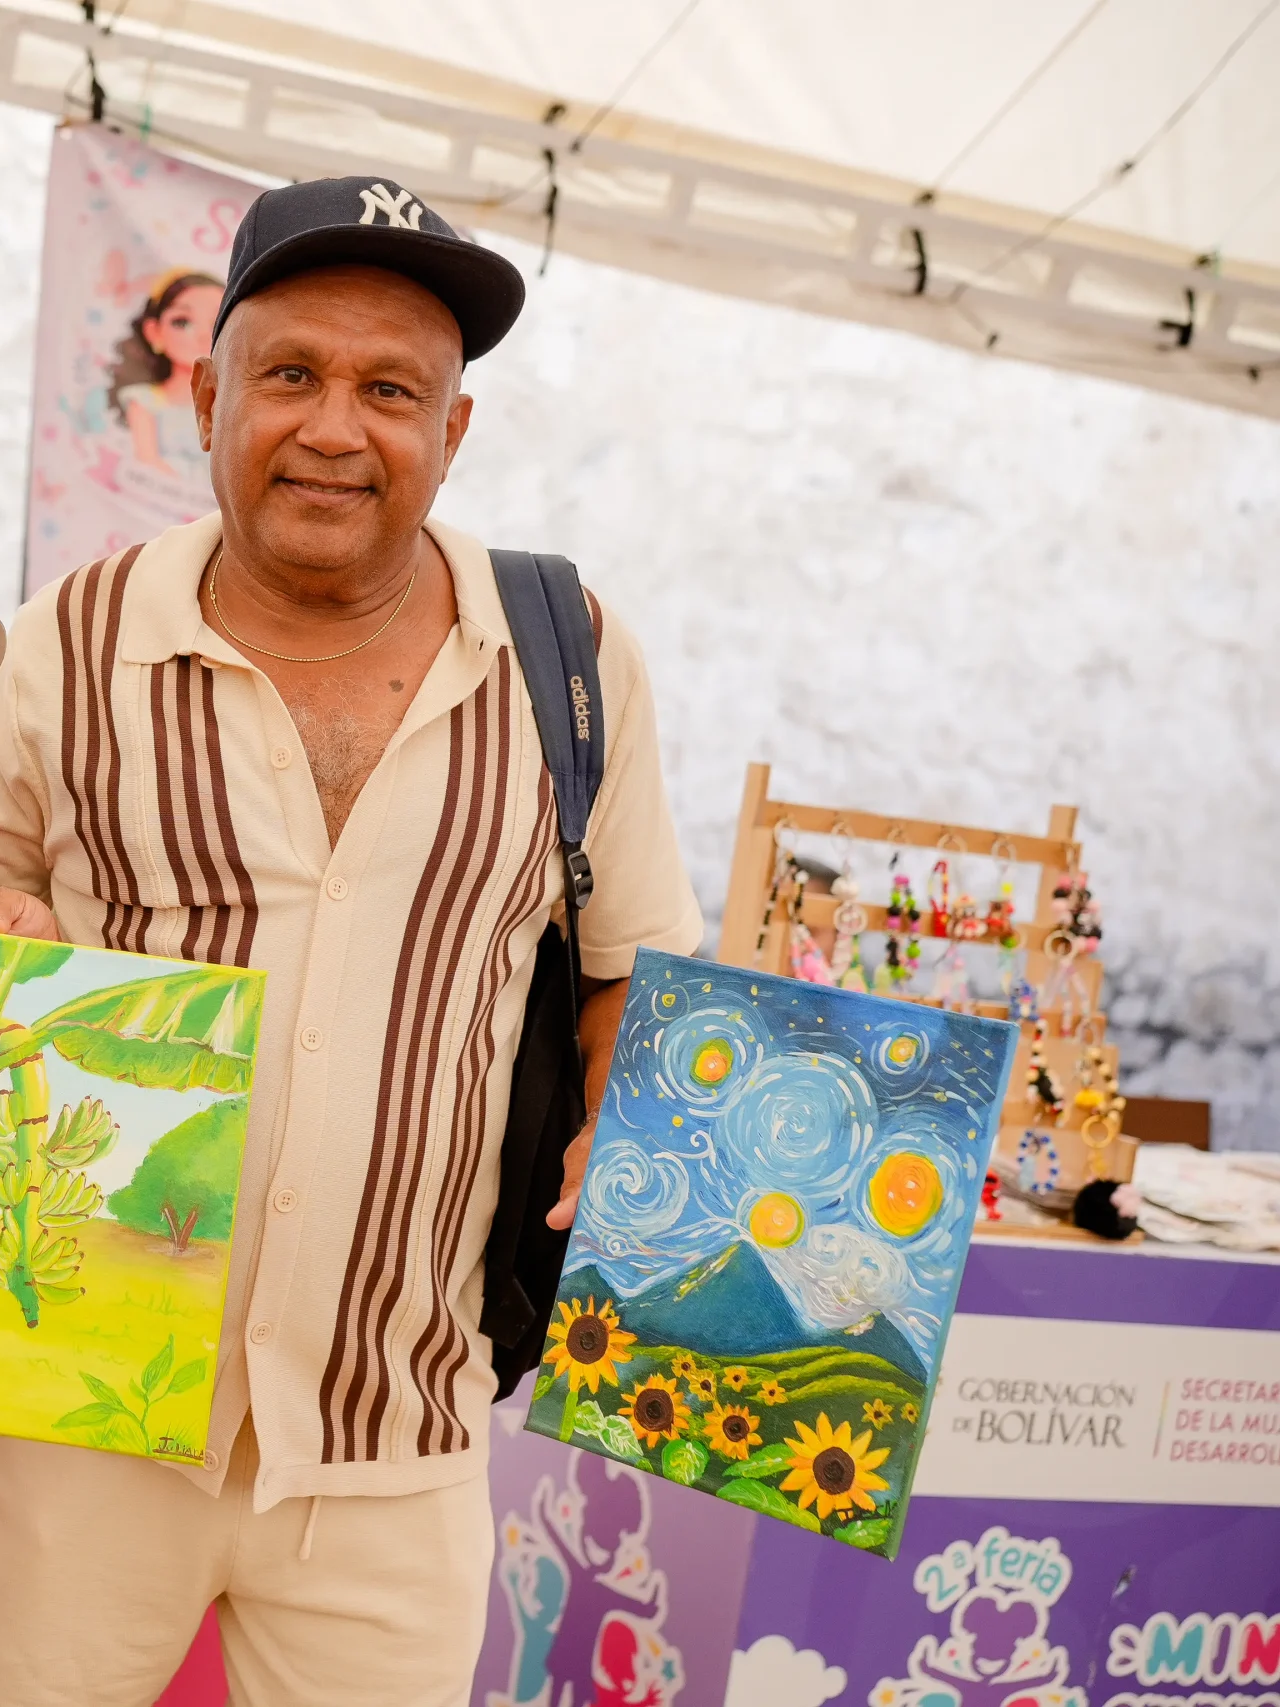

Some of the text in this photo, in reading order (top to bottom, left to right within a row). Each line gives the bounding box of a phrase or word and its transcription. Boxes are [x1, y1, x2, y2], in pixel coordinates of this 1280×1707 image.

[359, 183, 423, 231] NY
[570, 675, 591, 741] adidas
[958, 1377, 1136, 1408] GOBERNACIÓN
[951, 1407, 1127, 1448] DE BOLÍVAR
[1175, 1408, 1204, 1432] DE
[1209, 1411, 1234, 1433] LA
[984, 1537, 1063, 1596] feria
